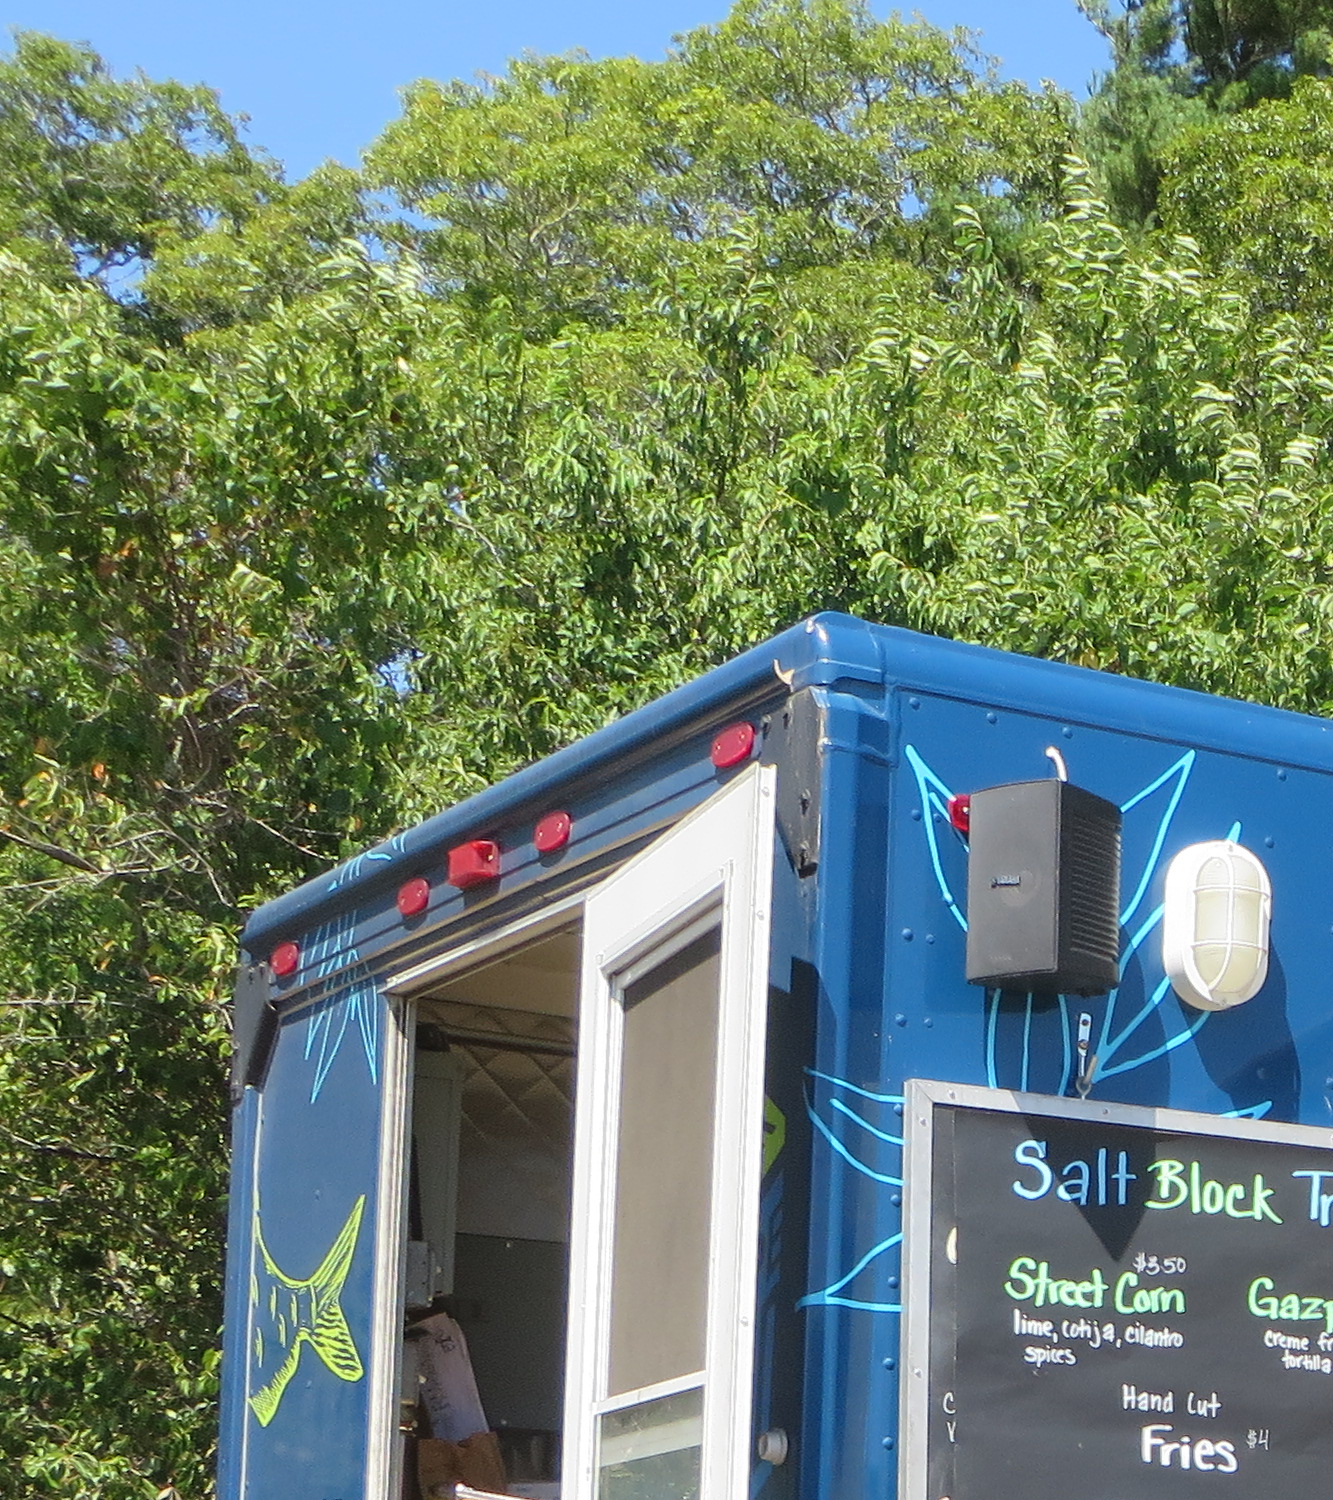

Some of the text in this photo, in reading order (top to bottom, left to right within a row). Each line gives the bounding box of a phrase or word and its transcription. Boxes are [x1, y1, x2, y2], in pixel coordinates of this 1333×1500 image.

[1012, 1139, 1137, 1206] Salt
[1144, 1159, 1284, 1225] Block
[1004, 1256, 1186, 1314] Street Corn
[1013, 1308, 1185, 1348] lime, cotija, cilantro
[1264, 1329, 1310, 1351] creme
[1024, 1344, 1077, 1368] spices
[1282, 1349, 1331, 1375] tortilla
[1121, 1384, 1222, 1418] Hand Cut
[1141, 1423, 1239, 1473] Fries
[1246, 1429, 1270, 1451] $4
